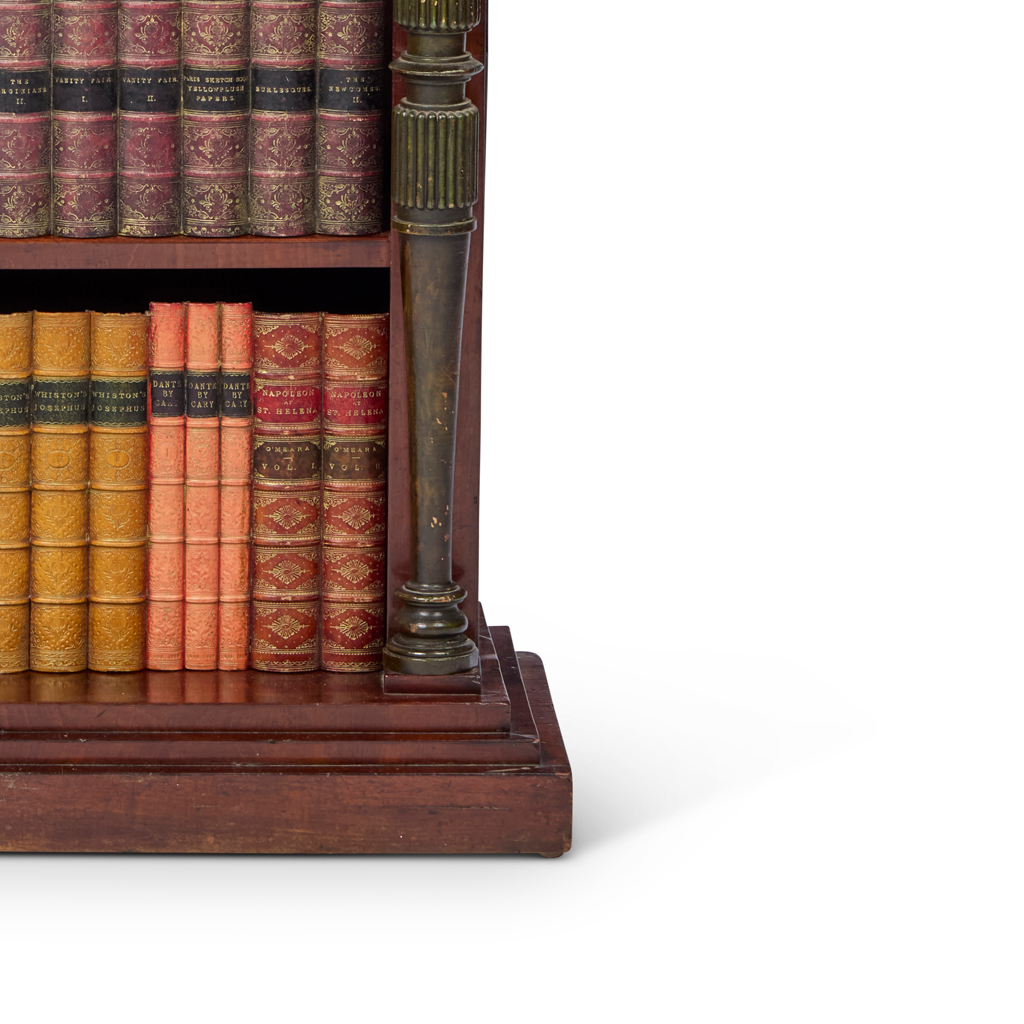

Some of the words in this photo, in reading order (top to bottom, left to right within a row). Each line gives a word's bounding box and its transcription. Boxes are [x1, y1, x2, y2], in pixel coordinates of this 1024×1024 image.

[54, 77, 85, 85] VANITY
[204, 76, 233, 84] SKETCH
[187, 85, 245, 93] YELLOWPLUSH
[81, 95, 88, 103] I.
[352, 96, 363, 104] II.
[152, 380, 182, 389] DANTE
[188, 382, 217, 391] DANTE
[223, 382, 251, 391] DANTE
[34, 390, 88, 399] WHISTON'S
[91, 390, 147, 400] WHISTON'S
[162, 390, 174, 398] BY
[197, 391, 209, 399] BY
[231, 391, 243, 399] BY
[262, 389, 315, 398] NAPOLEON
[330, 390, 382, 399] NAPOLEON
[34, 403, 86, 412] JOSEPHUS
[190, 400, 214, 408] CARY
[91, 404, 145, 413] JOSEPHUS
[256, 406, 271, 415] ST.
[276, 407, 318, 416] HELENA
[326, 409, 341, 417] ST.
[345, 408, 384, 417] HELENA
[265, 445, 310, 453] O'MEARA
[333, 446, 377, 454] O'MEARA
[261, 463, 297, 471] VOL.
[329, 463, 364, 471] VOL.
